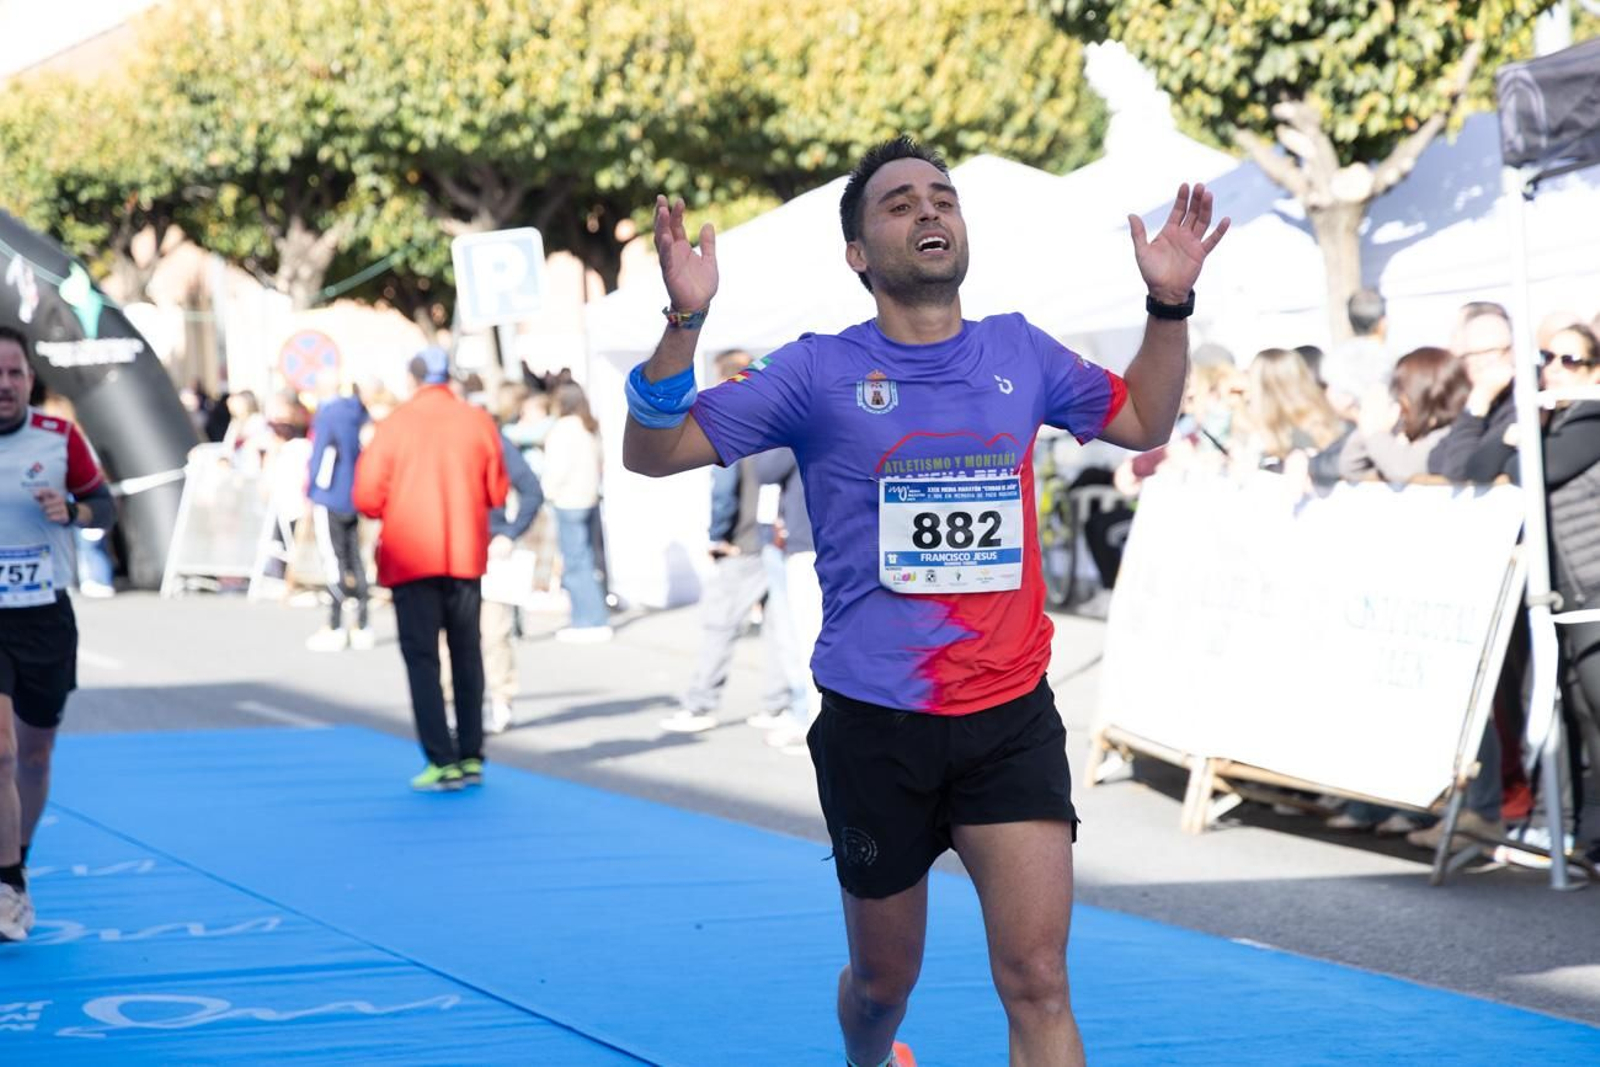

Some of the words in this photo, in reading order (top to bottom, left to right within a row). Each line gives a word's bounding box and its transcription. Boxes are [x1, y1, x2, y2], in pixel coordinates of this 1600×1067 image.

[472, 243, 528, 316] P
[885, 457, 951, 473] ATLETISMO
[954, 456, 961, 468] Y
[912, 510, 1002, 549] 882
[920, 553, 971, 562] FRANCISCO
[973, 551, 997, 561] JESUS
